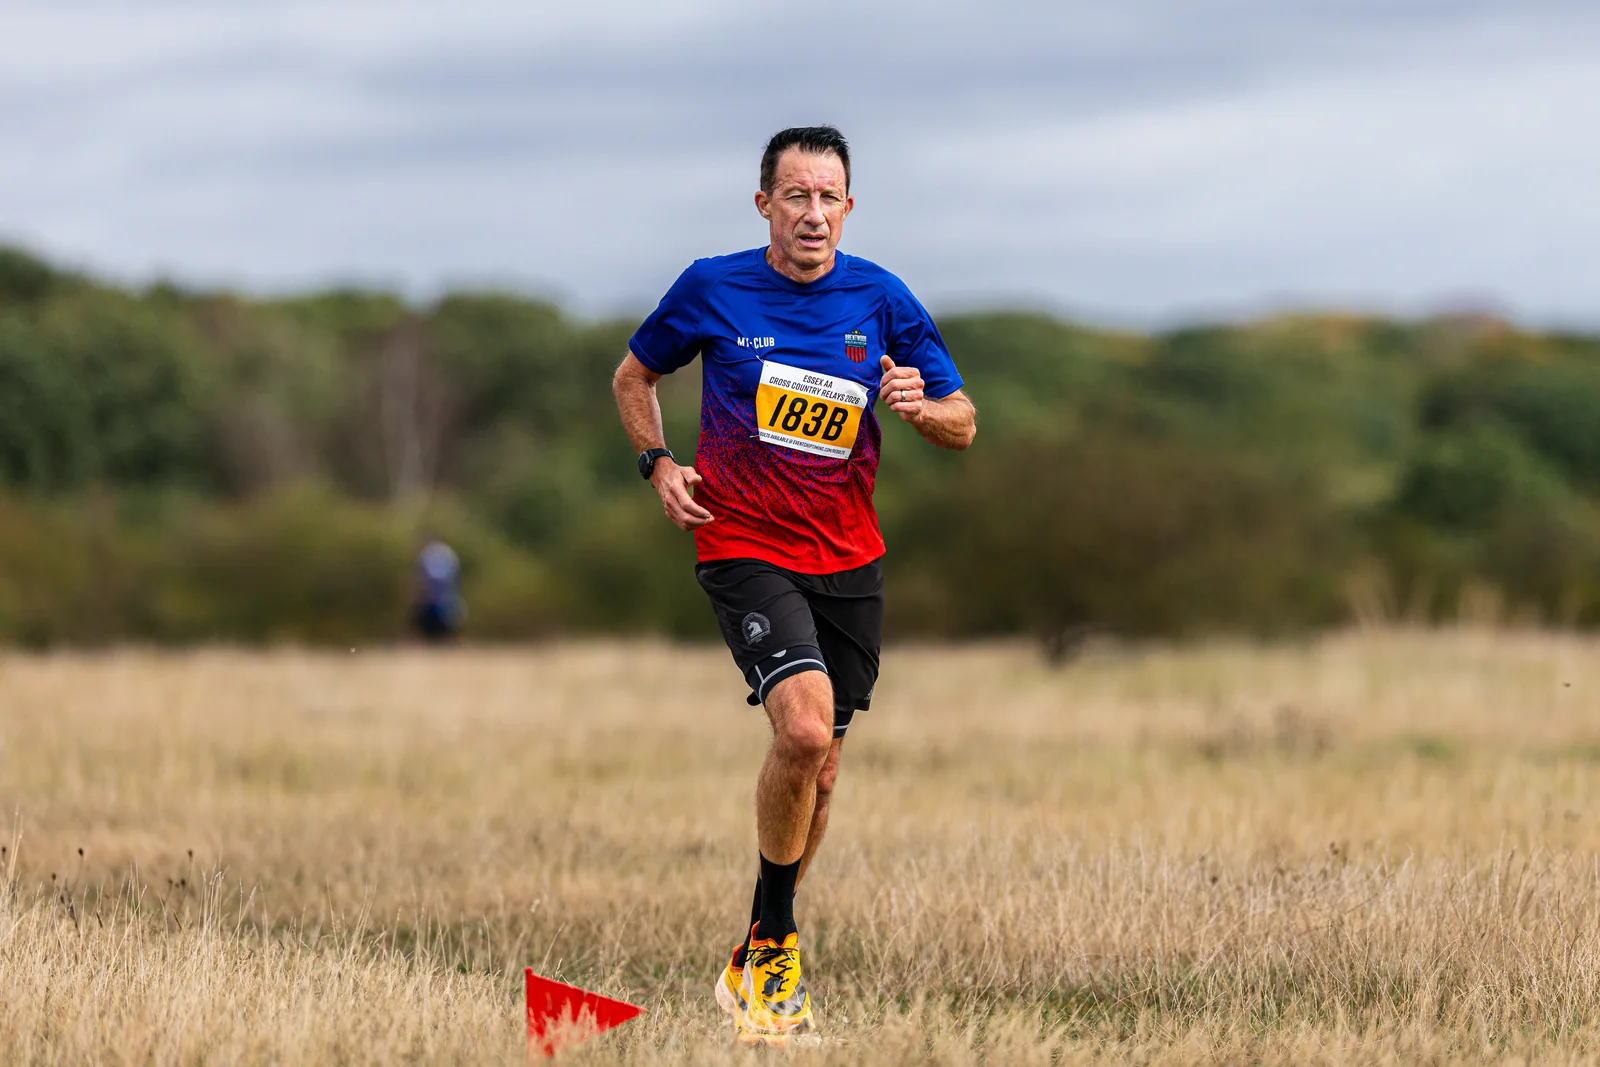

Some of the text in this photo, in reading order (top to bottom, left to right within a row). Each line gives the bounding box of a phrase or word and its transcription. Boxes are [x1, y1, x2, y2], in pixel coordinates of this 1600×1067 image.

[769, 376, 861, 405] CROSS COUNTRY RELAYS 2026
[803, 374, 833, 389] ESSEX AA
[768, 394, 849, 441] 183B
[770, 434, 789, 444] AVAILABLE
